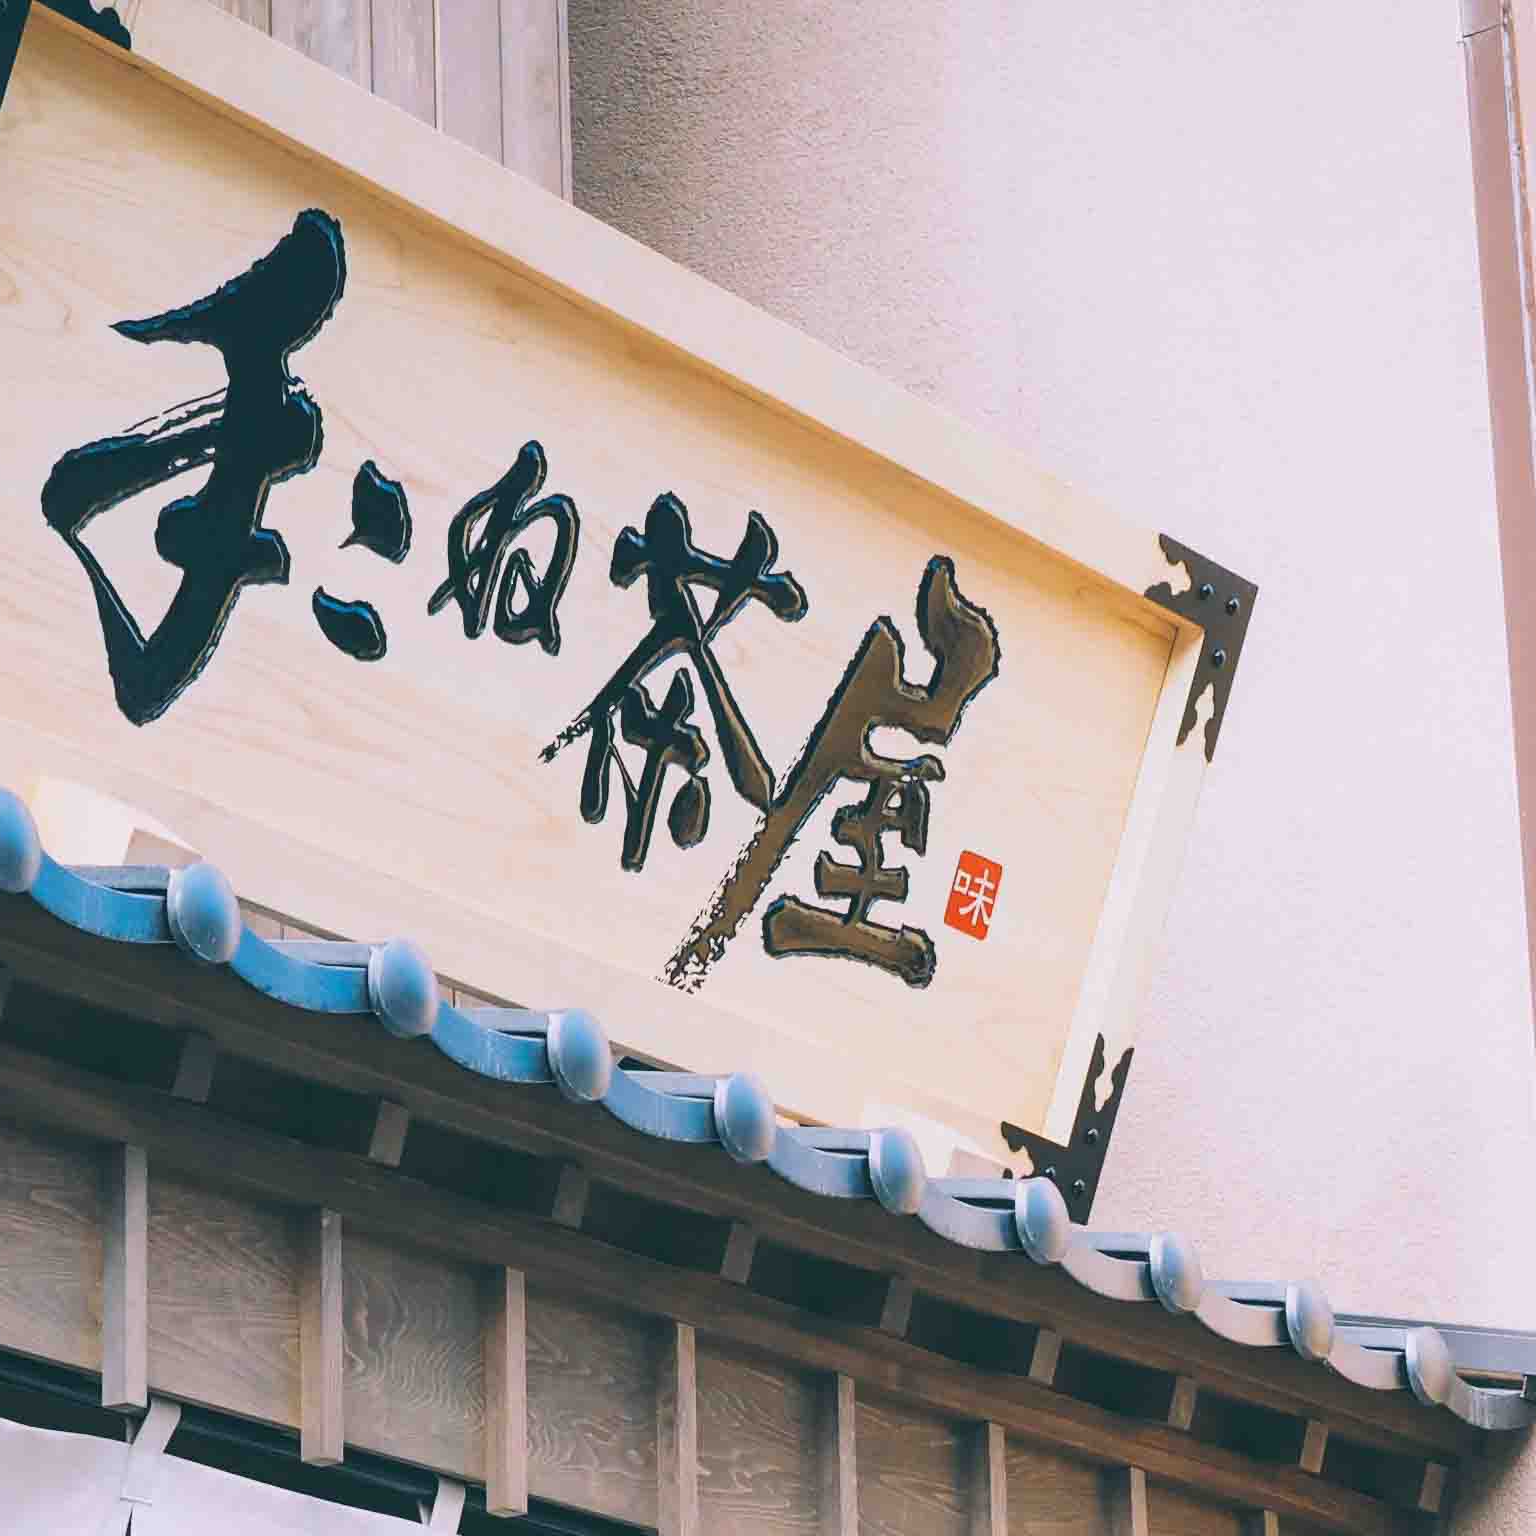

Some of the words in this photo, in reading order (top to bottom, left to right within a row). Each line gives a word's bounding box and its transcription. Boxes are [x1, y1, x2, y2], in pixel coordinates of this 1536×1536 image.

[41, 206, 1001, 994] 手こね茶屋
[951, 865, 998, 930] 味
